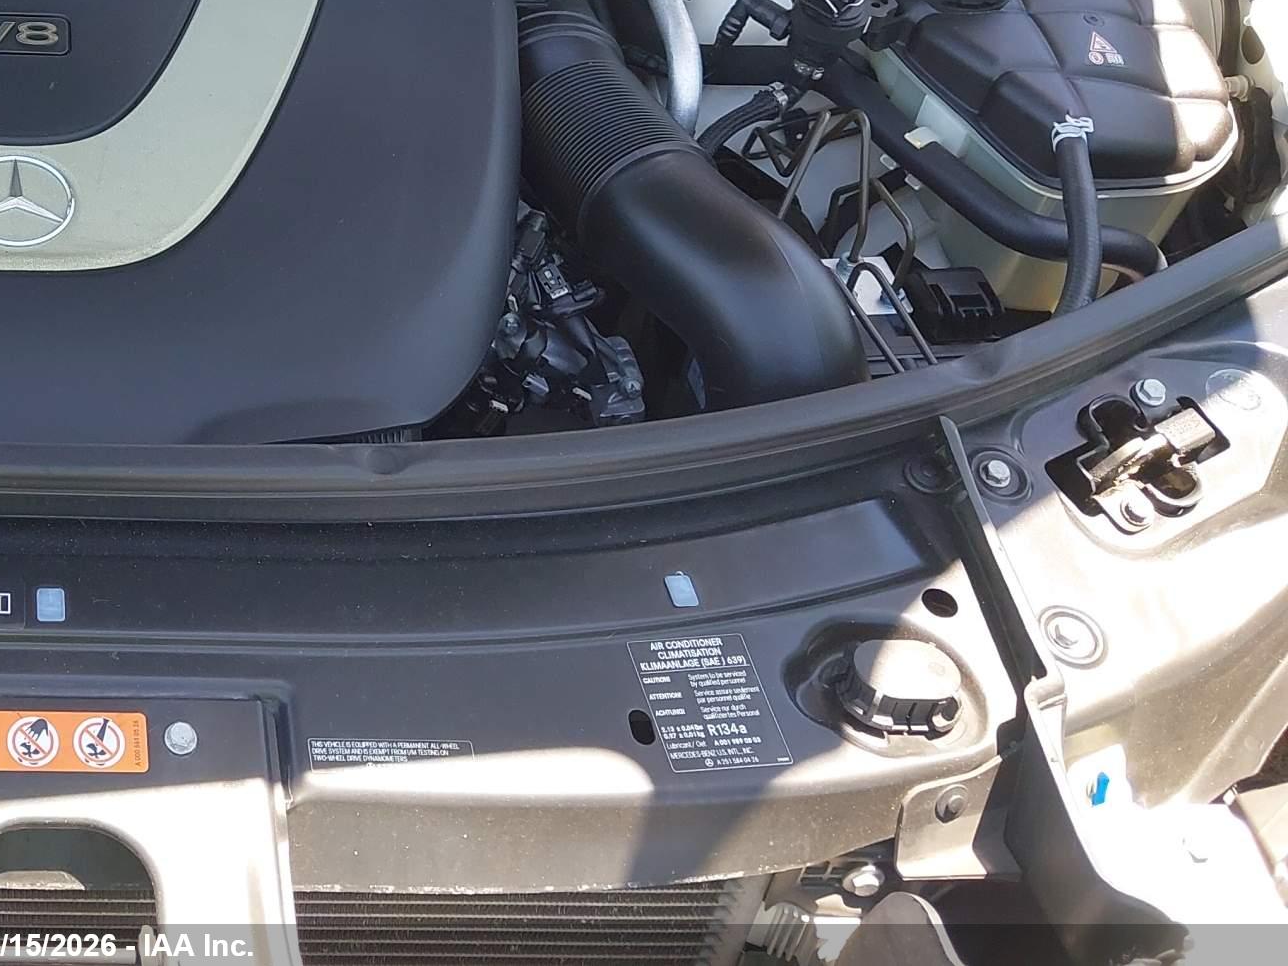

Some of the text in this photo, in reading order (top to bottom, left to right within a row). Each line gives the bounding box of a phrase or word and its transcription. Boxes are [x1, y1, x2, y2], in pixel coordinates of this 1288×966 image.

[650, 637, 723, 651] AIR CONDITIONER
[657, 647, 722, 660] CLIMATISATION
[639, 658, 701, 671] KLIMAANLAGE
[701, 657, 721, 669] (SAE
[727, 655, 746, 666] 639)
[688, 673, 709, 682] System
[694, 689, 714, 697] Service
[700, 705, 721, 713] Service
[706, 723, 748, 736] R134a
[328, 747, 350, 755] SYSTEM
